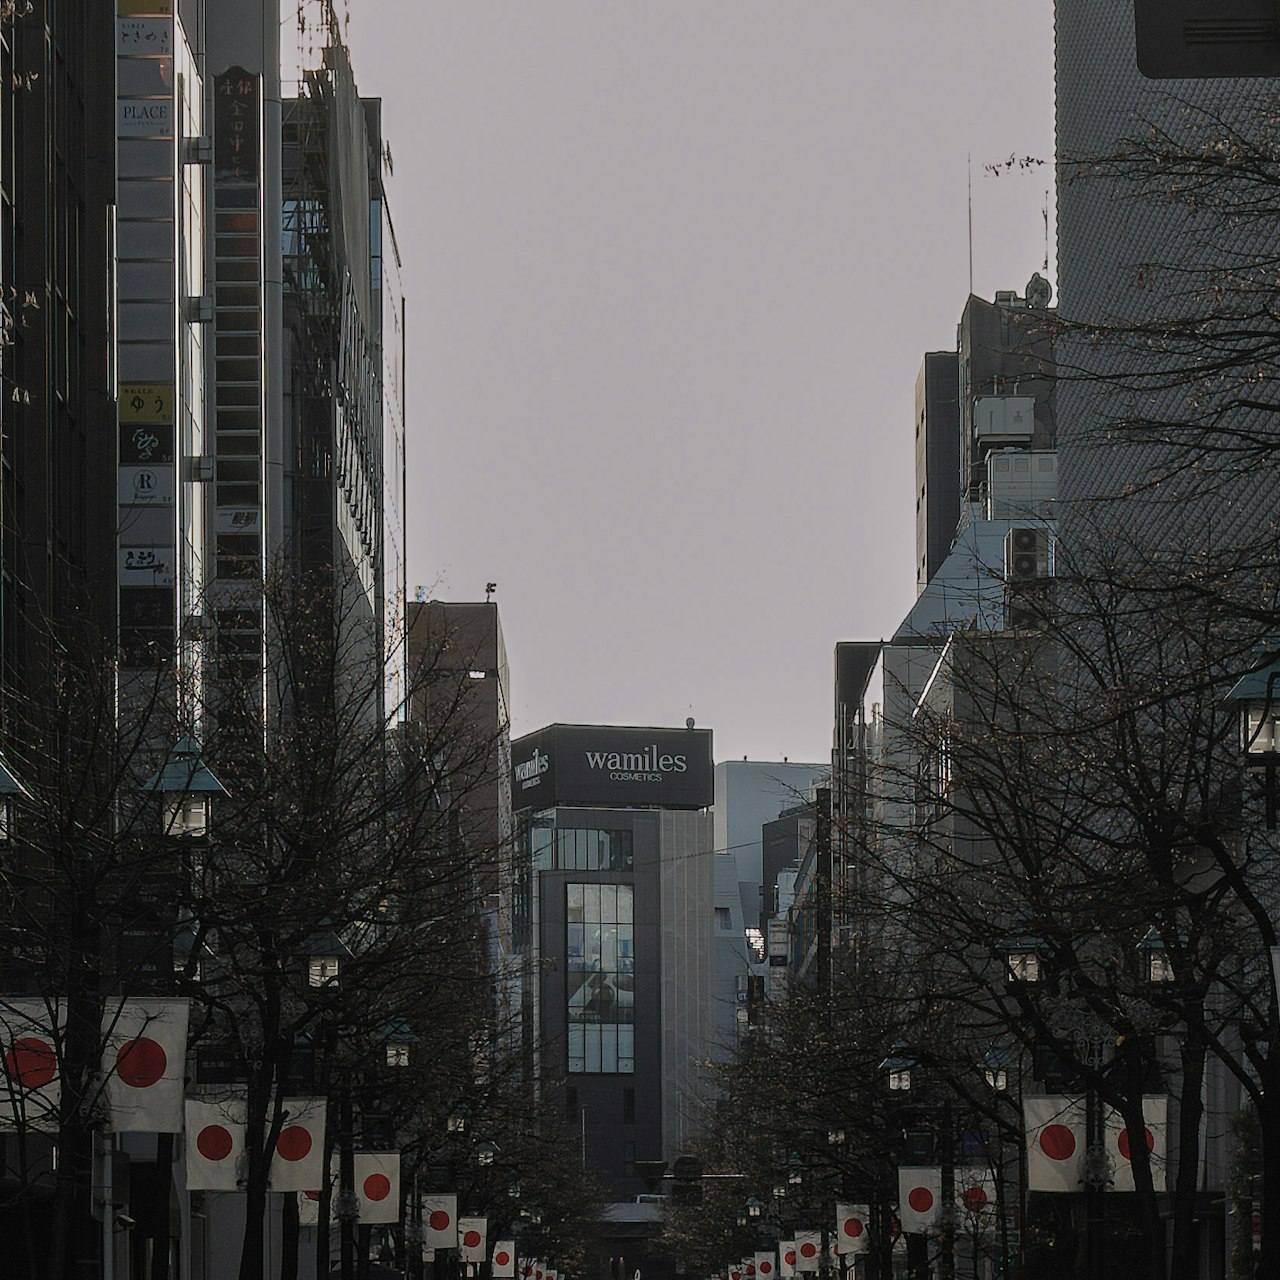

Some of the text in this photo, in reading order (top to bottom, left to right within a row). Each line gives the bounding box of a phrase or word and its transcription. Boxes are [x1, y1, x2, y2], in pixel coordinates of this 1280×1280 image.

[123, 106, 167, 120] PLACE
[585, 744, 688, 773] wamiles
[609, 771, 663, 782] COSMETICS
